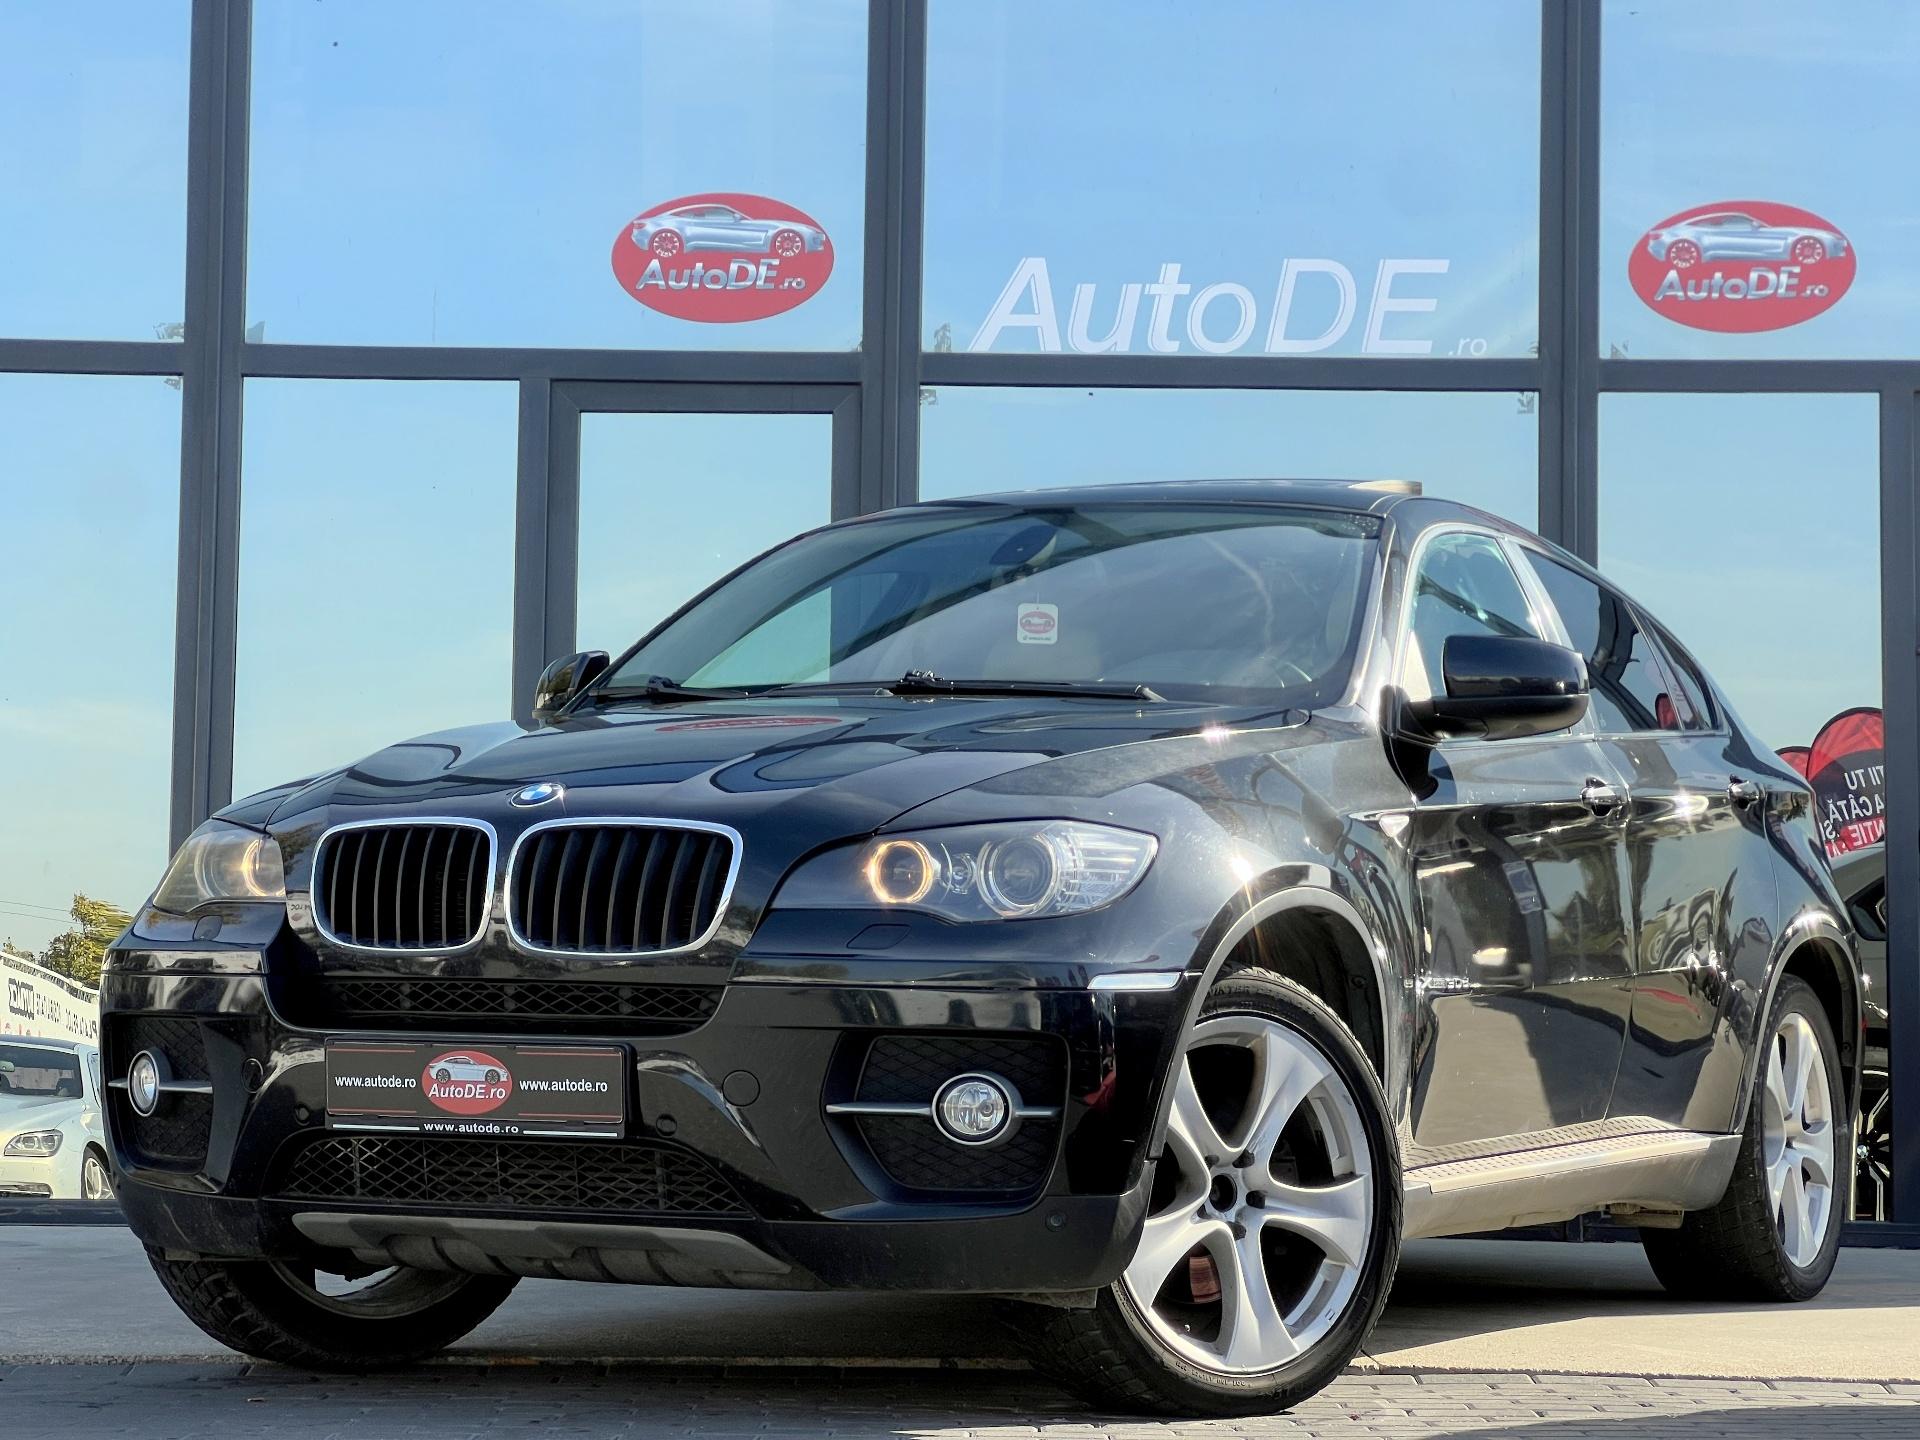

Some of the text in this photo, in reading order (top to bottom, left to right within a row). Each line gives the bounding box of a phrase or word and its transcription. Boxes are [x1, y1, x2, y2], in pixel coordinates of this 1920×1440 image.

[334, 1074, 417, 1088] www.autode.ro
[519, 1079, 608, 1093] www.autode.ro
[428, 1083, 506, 1100] AutoDE.ro
[424, 1121, 519, 1134] www.autode.ro
